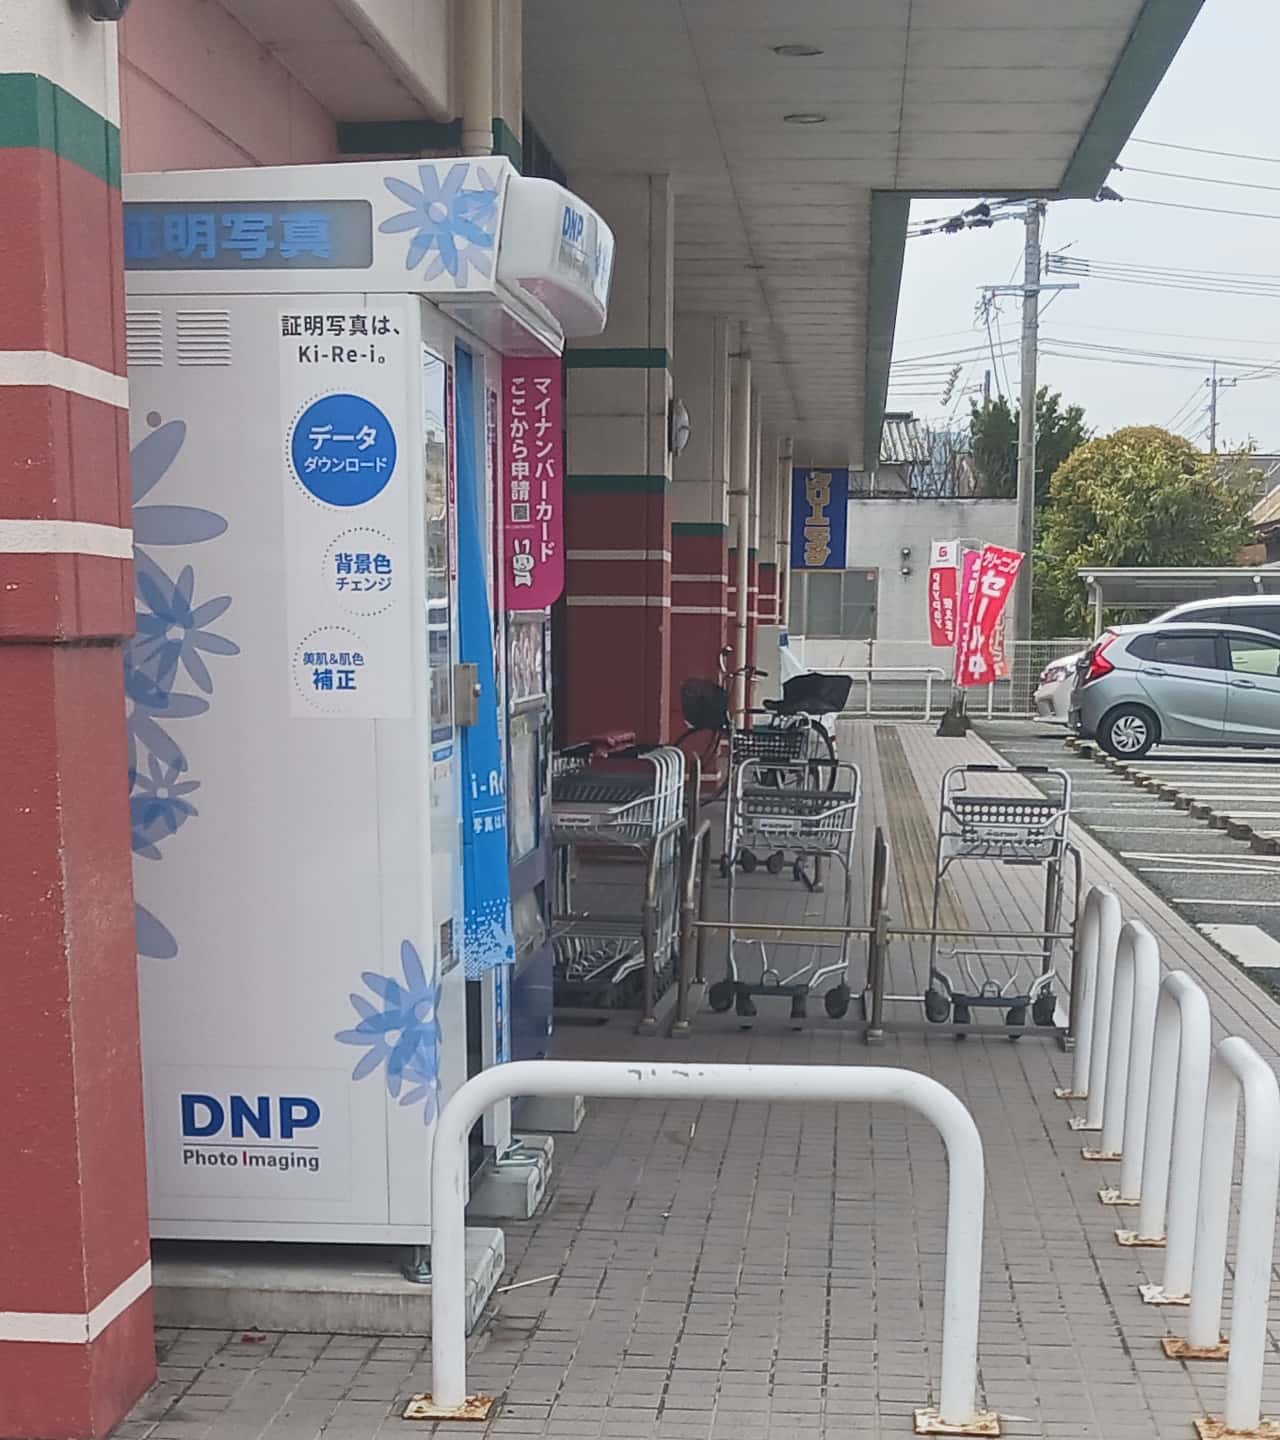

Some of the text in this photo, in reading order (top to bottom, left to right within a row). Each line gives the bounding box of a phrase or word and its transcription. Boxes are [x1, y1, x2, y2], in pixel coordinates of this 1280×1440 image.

[562, 206, 584, 243] DNP
[281, 314, 400, 336] 証明写真は、
[308, 424, 377, 451] データ
[510, 377, 529, 501] ここから申請
[304, 456, 387, 472] ダウンロード
[533, 377, 555, 562] マイナンバーカード
[335, 552, 392, 575] 背景色
[335, 576, 392, 591] チェンジ
[967, 568, 1007, 679] セール中
[302, 652, 365, 666] 美肌&肌色
[312, 668, 357, 690] 補正
[181, 1093, 320, 1139] DNP
[183, 1149, 320, 1171] Photo Imaging
